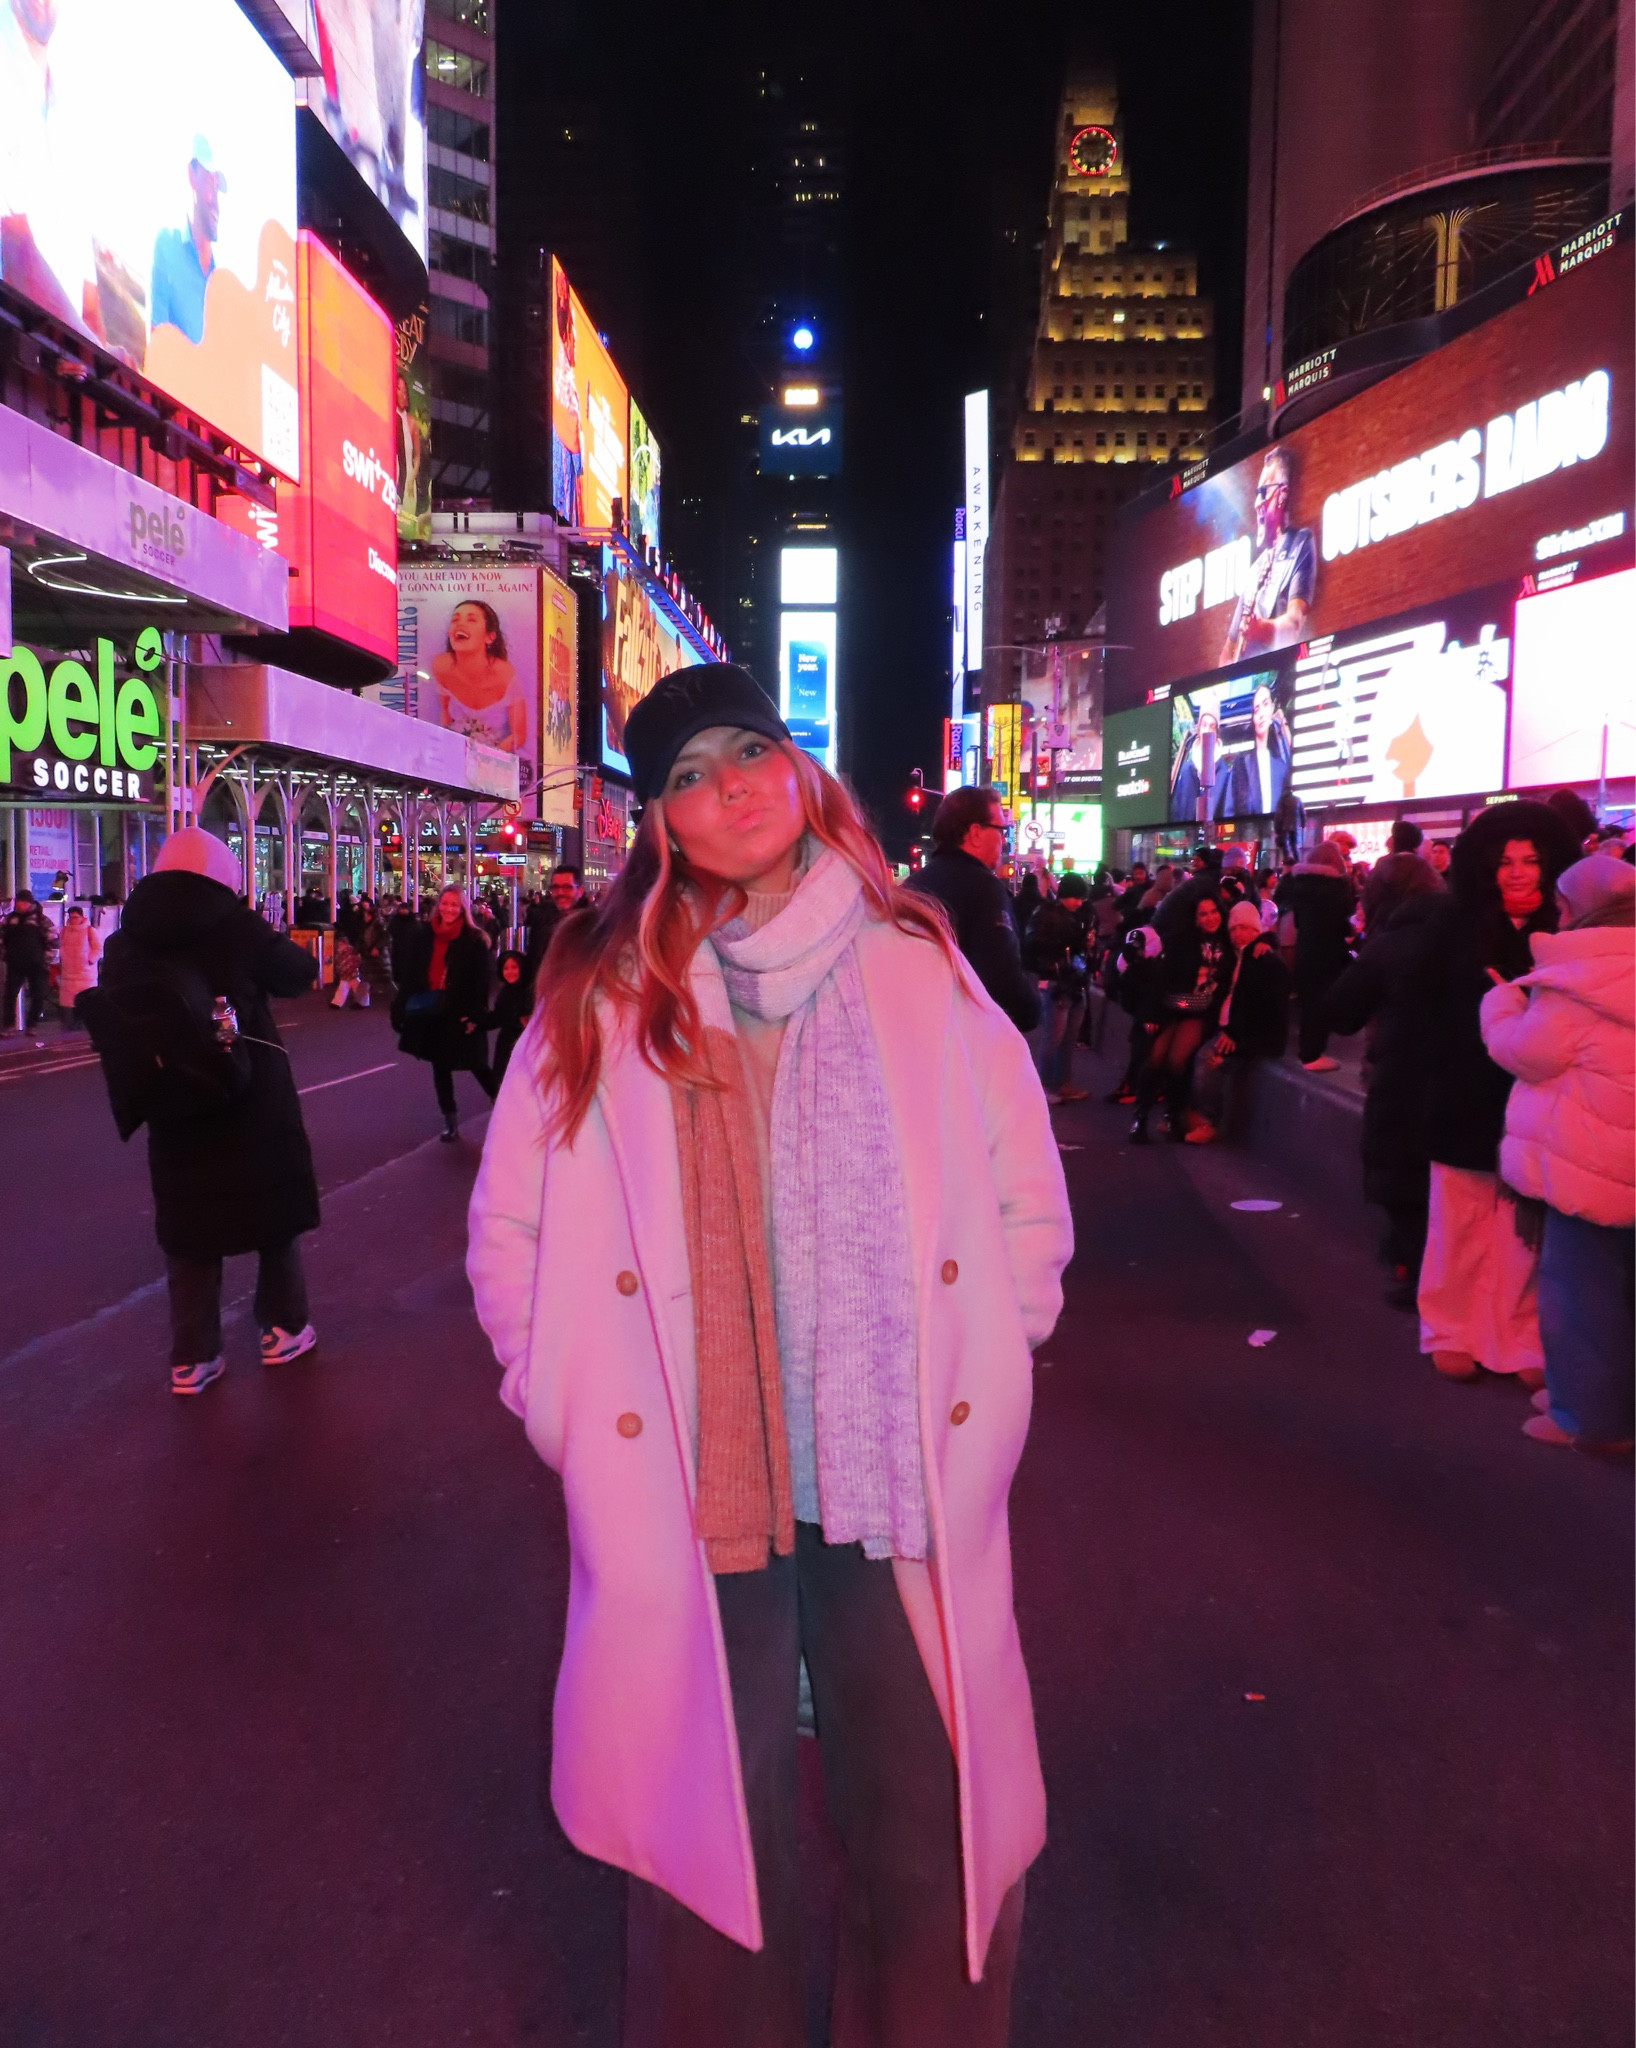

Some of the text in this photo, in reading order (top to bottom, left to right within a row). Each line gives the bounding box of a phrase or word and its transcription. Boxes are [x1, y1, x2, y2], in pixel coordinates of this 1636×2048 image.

[1561, 213, 1622, 258] MARRIOTT
[1560, 234, 1613, 273] MARQUIS
[1287, 366, 1330, 397] MARQUIS
[1288, 348, 1337, 382] MARRIOTT
[771, 428, 831, 446] KIA
[1321, 369, 1610, 562] OUTSIDERS RADIO
[142, 543, 176, 566] SOCCER
[973, 466, 983, 611] AWAKENING
[408, 583, 444, 593] GONNA
[447, 583, 473, 593] LOVE
[476, 583, 494, 593] IT...
[498, 583, 534, 593] AGAIN!
[423, 572, 469, 581] ALREADY
[471, 572, 501, 581] KNOW
[1159, 558, 1204, 626] STEP
[798, 688, 817, 697] New
[33, 758, 141, 799] SOCCER
